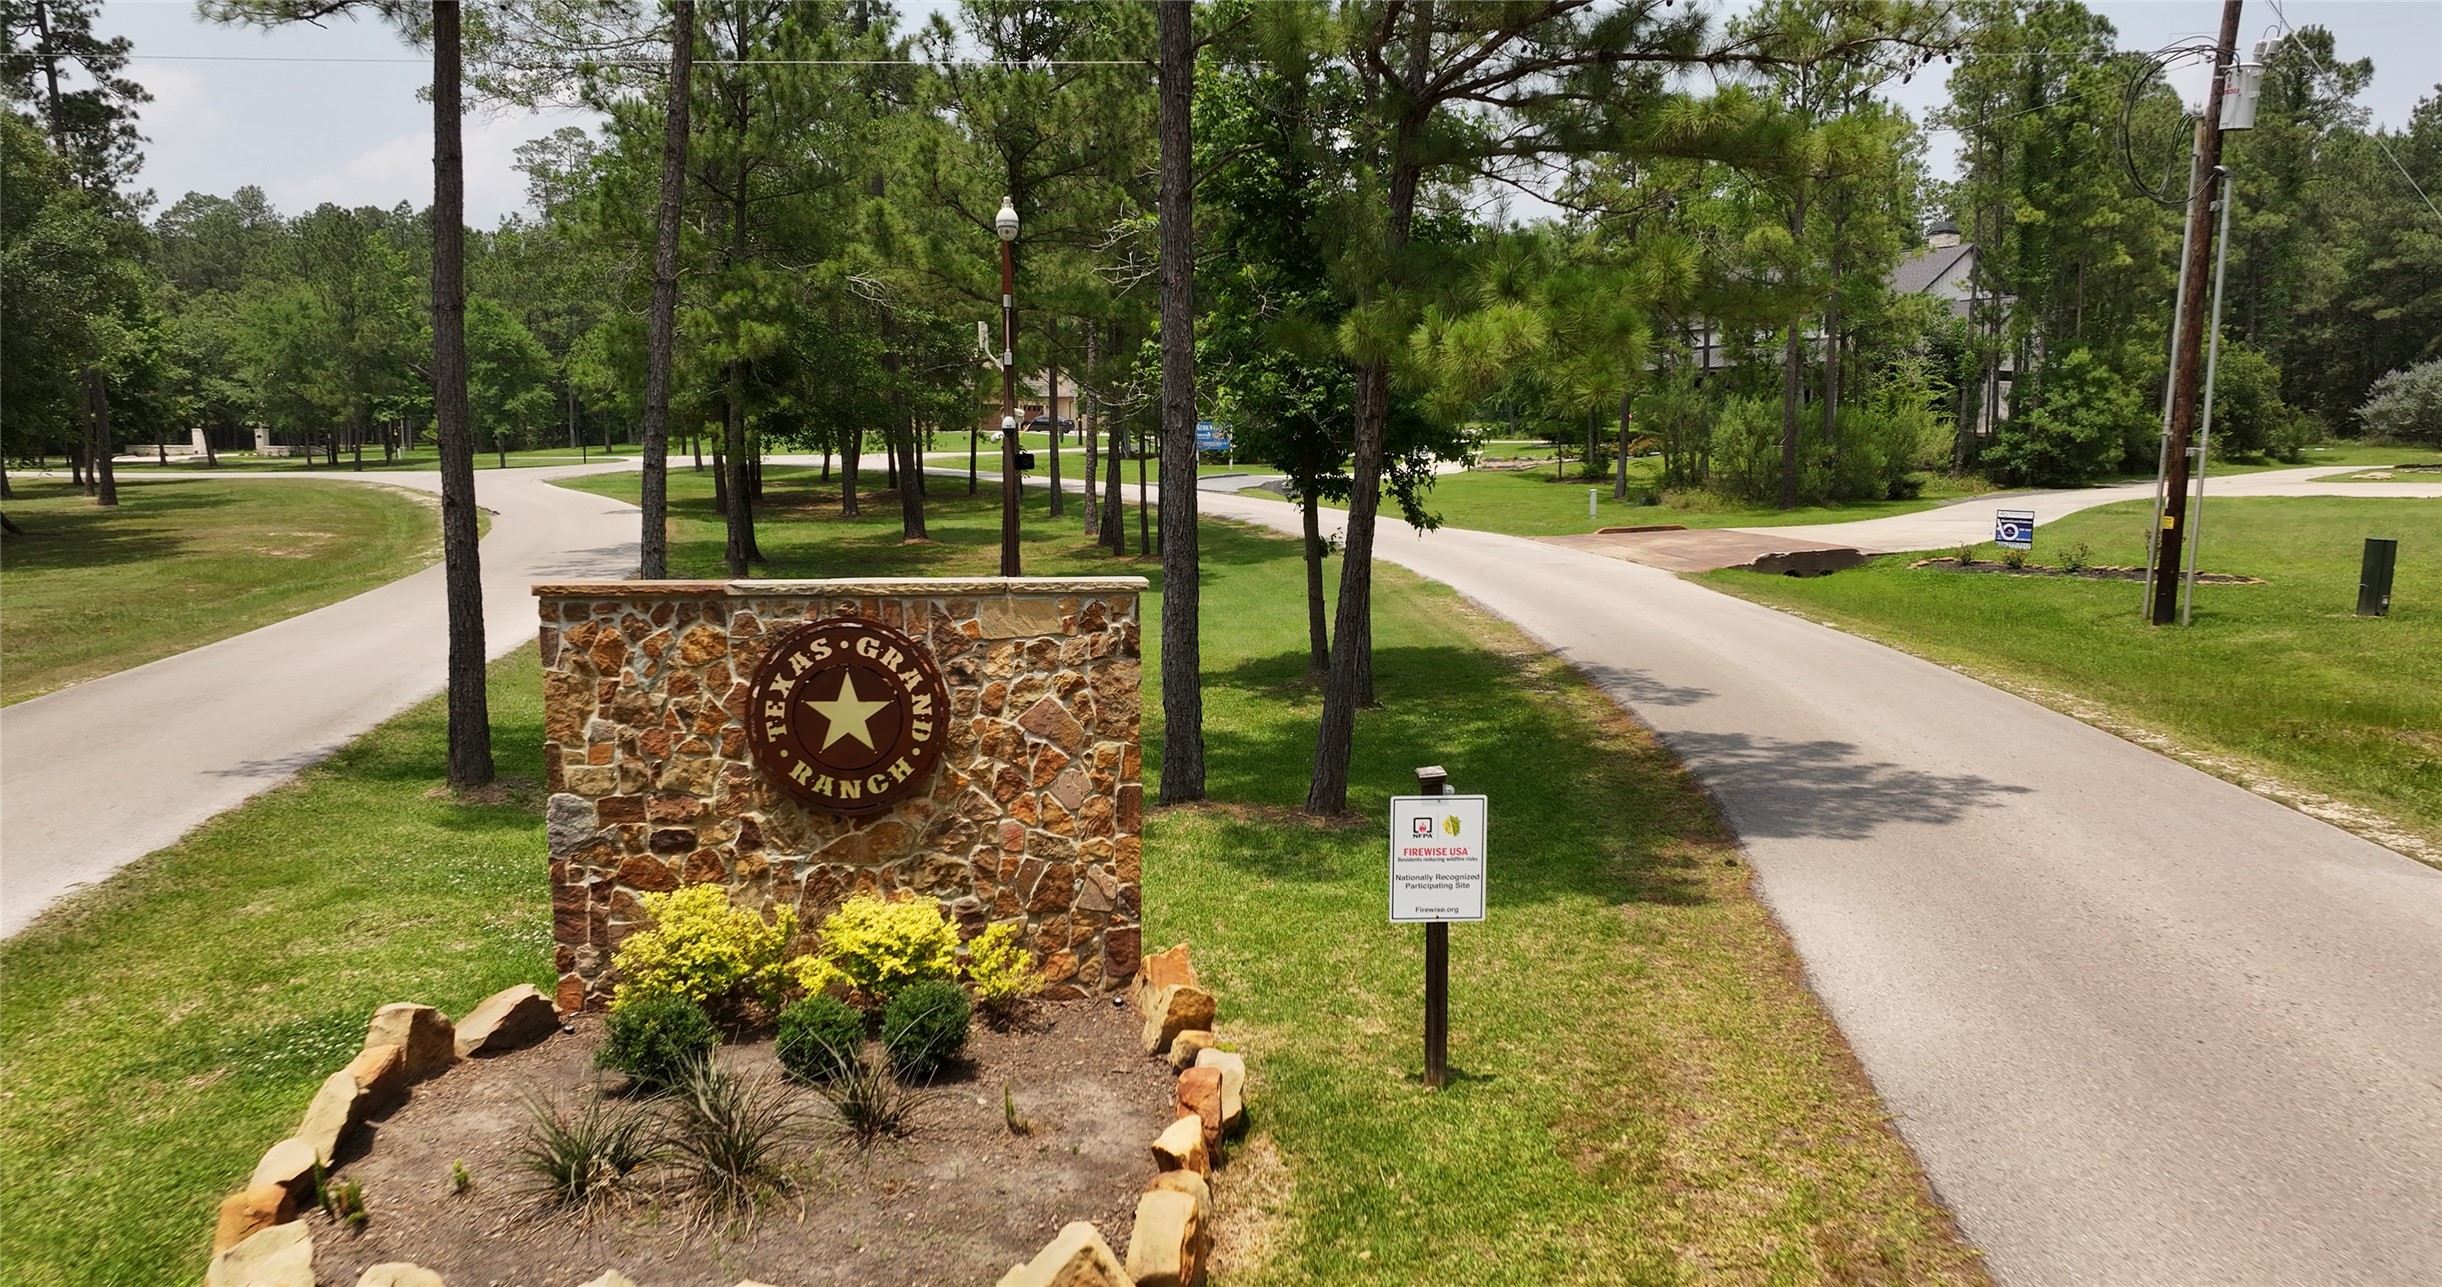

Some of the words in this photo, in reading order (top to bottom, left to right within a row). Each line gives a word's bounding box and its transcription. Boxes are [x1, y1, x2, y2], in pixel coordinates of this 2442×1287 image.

[765, 637, 833, 743] TEXAS
[856, 636, 933, 742] GRAND
[788, 757, 915, 799] RANCH
[1403, 847, 1447, 856] FIREWISE
[1449, 847, 1468, 856] USA
[1395, 874, 1433, 882] Nationally
[1435, 873, 1480, 881] Recognized
[1405, 882, 1453, 890] Participating
[1415, 906, 1459, 914] Firewise.org
